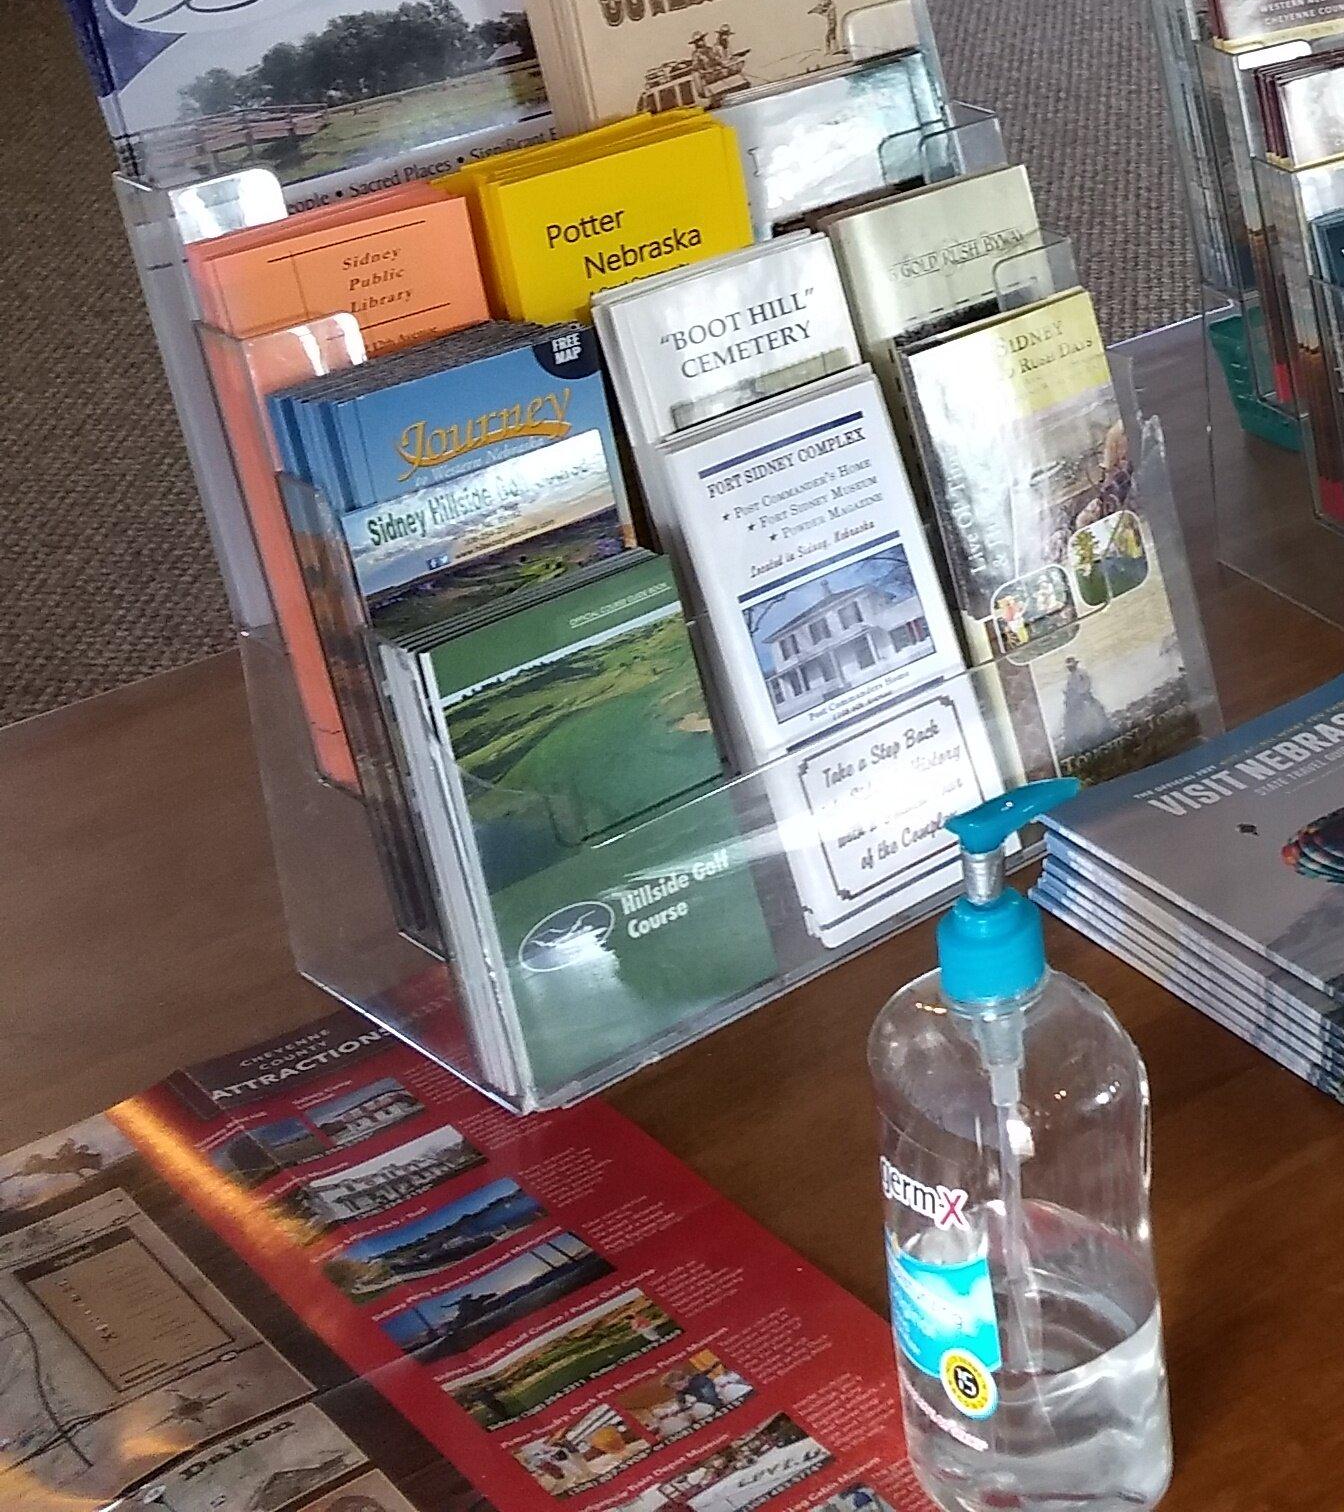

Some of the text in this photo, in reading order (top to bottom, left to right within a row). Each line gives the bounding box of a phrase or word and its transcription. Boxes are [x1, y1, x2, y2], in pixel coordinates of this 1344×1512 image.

[1265, 8, 1316, 25] CHEYENNE
[349, 158, 451, 198] Sacred Places
[546, 210, 625, 248] Potter
[342, 247, 402, 270] Sidney
[584, 228, 702, 278] Nebraska
[349, 267, 405, 291] Public
[350, 288, 413, 313] Library
[552, 333, 581, 349] FREE
[554, 345, 582, 365] MAP
[681, 320, 811, 380] CEMETERY
[397, 388, 571, 481] Journey
[707, 427, 866, 499] FORT SIDNEY COMPLEX
[367, 508, 427, 546] Sidney
[427, 485, 492, 526] Hillside
[823, 762, 855, 788] Take
[870, 740, 901, 765] Step
[903, 718, 940, 749] Back
[1147, 770, 1248, 817] VISIT
[1254, 776, 1287, 796] STATE
[1287, 759, 1328, 785] TRAVEL
[620, 849, 729, 915] Hillside Golf
[627, 902, 689, 939] Course
[240, 1029, 331, 1068] CHEYENNE
[258, 1040, 328, 1071] COUNTY
[179, 1420, 298, 1481] Dalton
